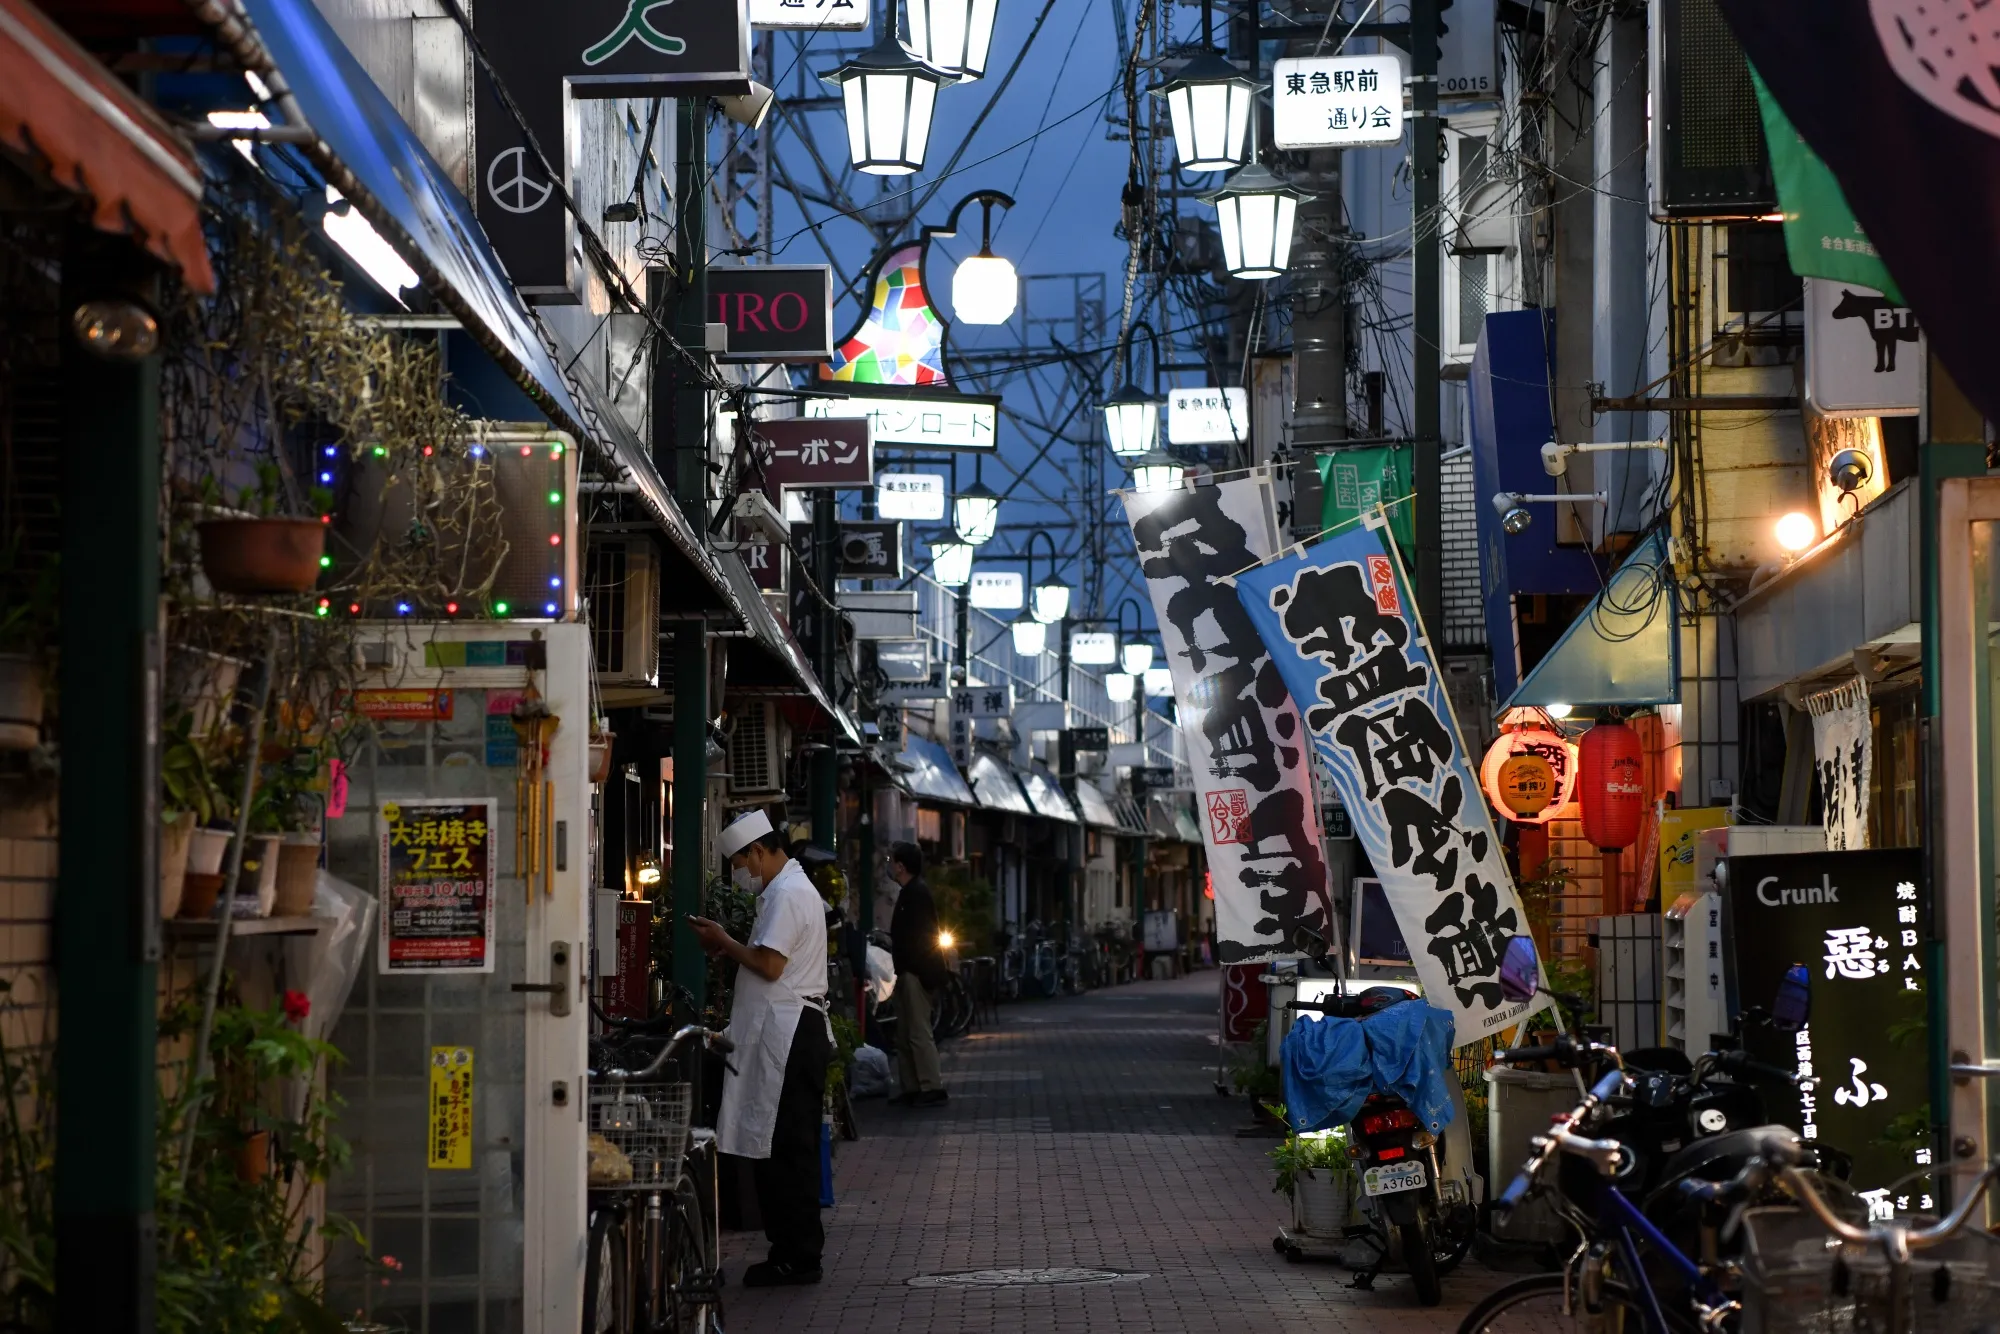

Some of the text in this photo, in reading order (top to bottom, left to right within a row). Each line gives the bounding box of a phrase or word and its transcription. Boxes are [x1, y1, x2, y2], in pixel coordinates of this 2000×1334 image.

[1285, 69, 1379, 95] 東急駅前
[1328, 105, 1391, 130] 通り会
[1509, 781, 1547, 791] 一番搾り
[390, 817, 488, 847] 大浜焼き
[406, 847, 473, 870] フェス
[1757, 873, 1840, 907] Crunk
[1795, 1023, 1817, 1139] 区西蒲田七丁目
[1383, 1174, 1421, 1190] A3760
